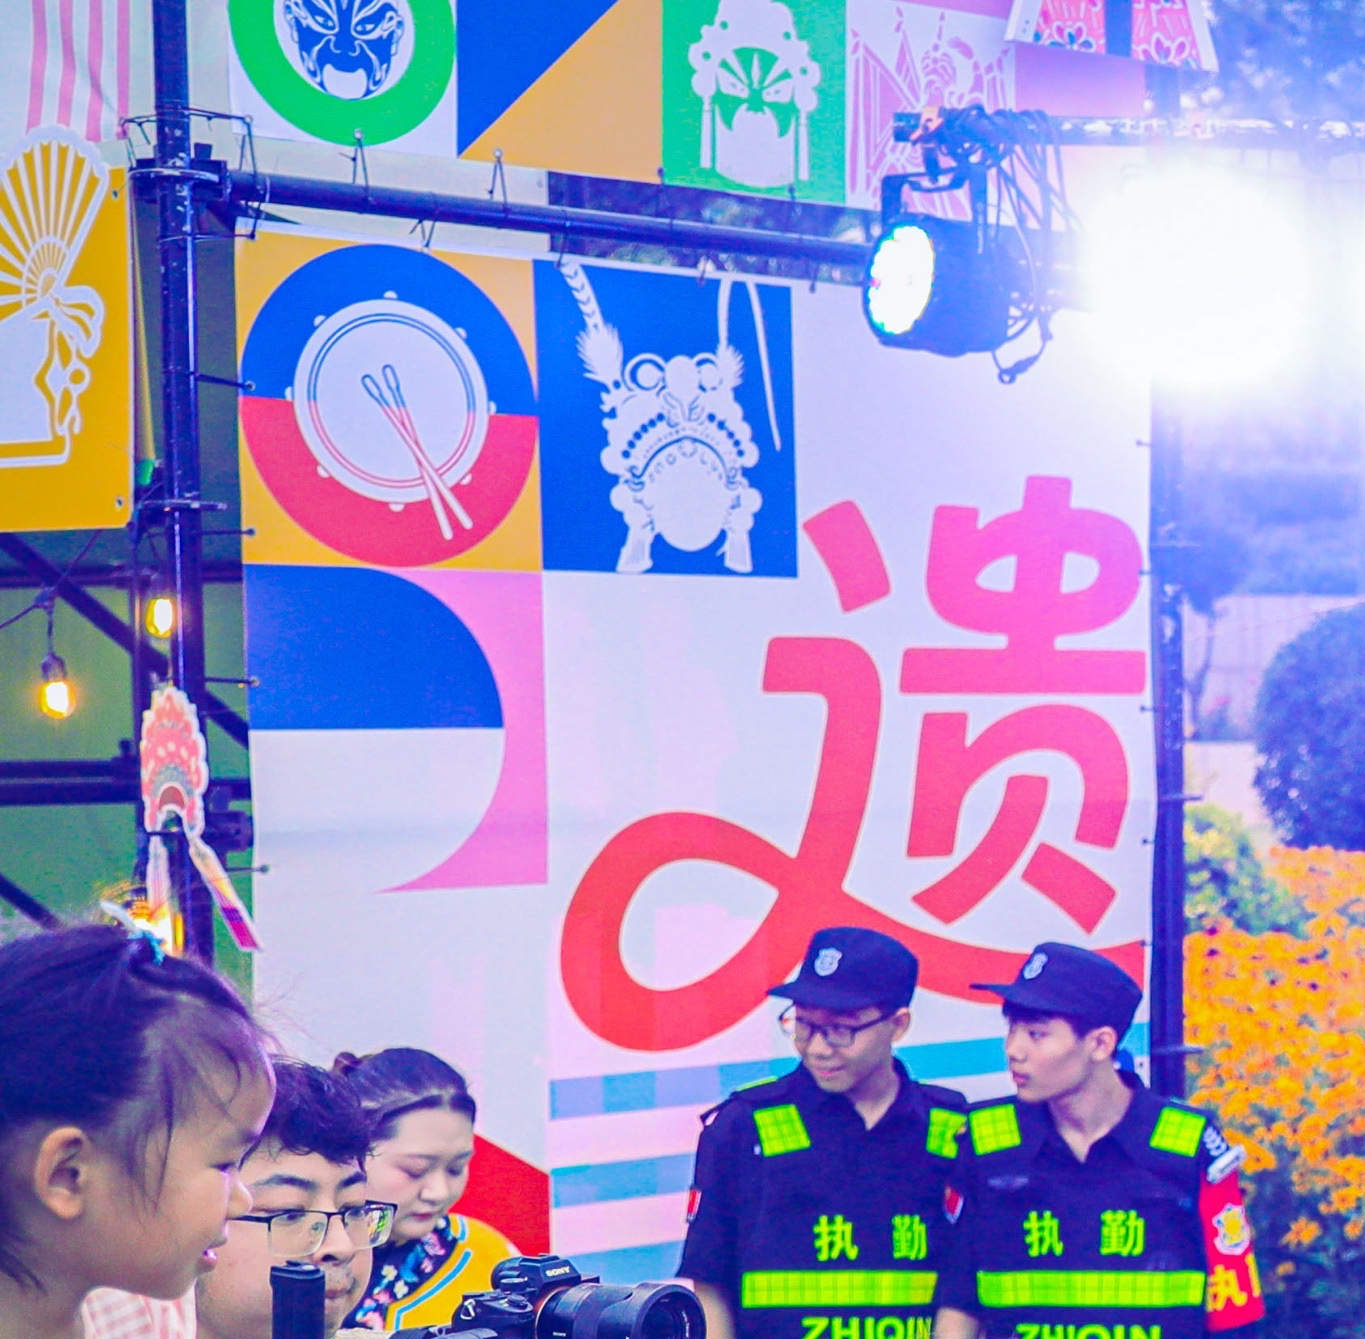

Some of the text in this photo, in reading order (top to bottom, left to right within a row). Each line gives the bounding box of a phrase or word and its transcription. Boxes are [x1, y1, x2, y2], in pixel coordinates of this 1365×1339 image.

[559, 475, 1147, 1052] 遗
[813, 1214, 929, 1263] 执勤
[1022, 1209, 1147, 1258] 执勤
[545, 1265, 570, 1277] SONY
